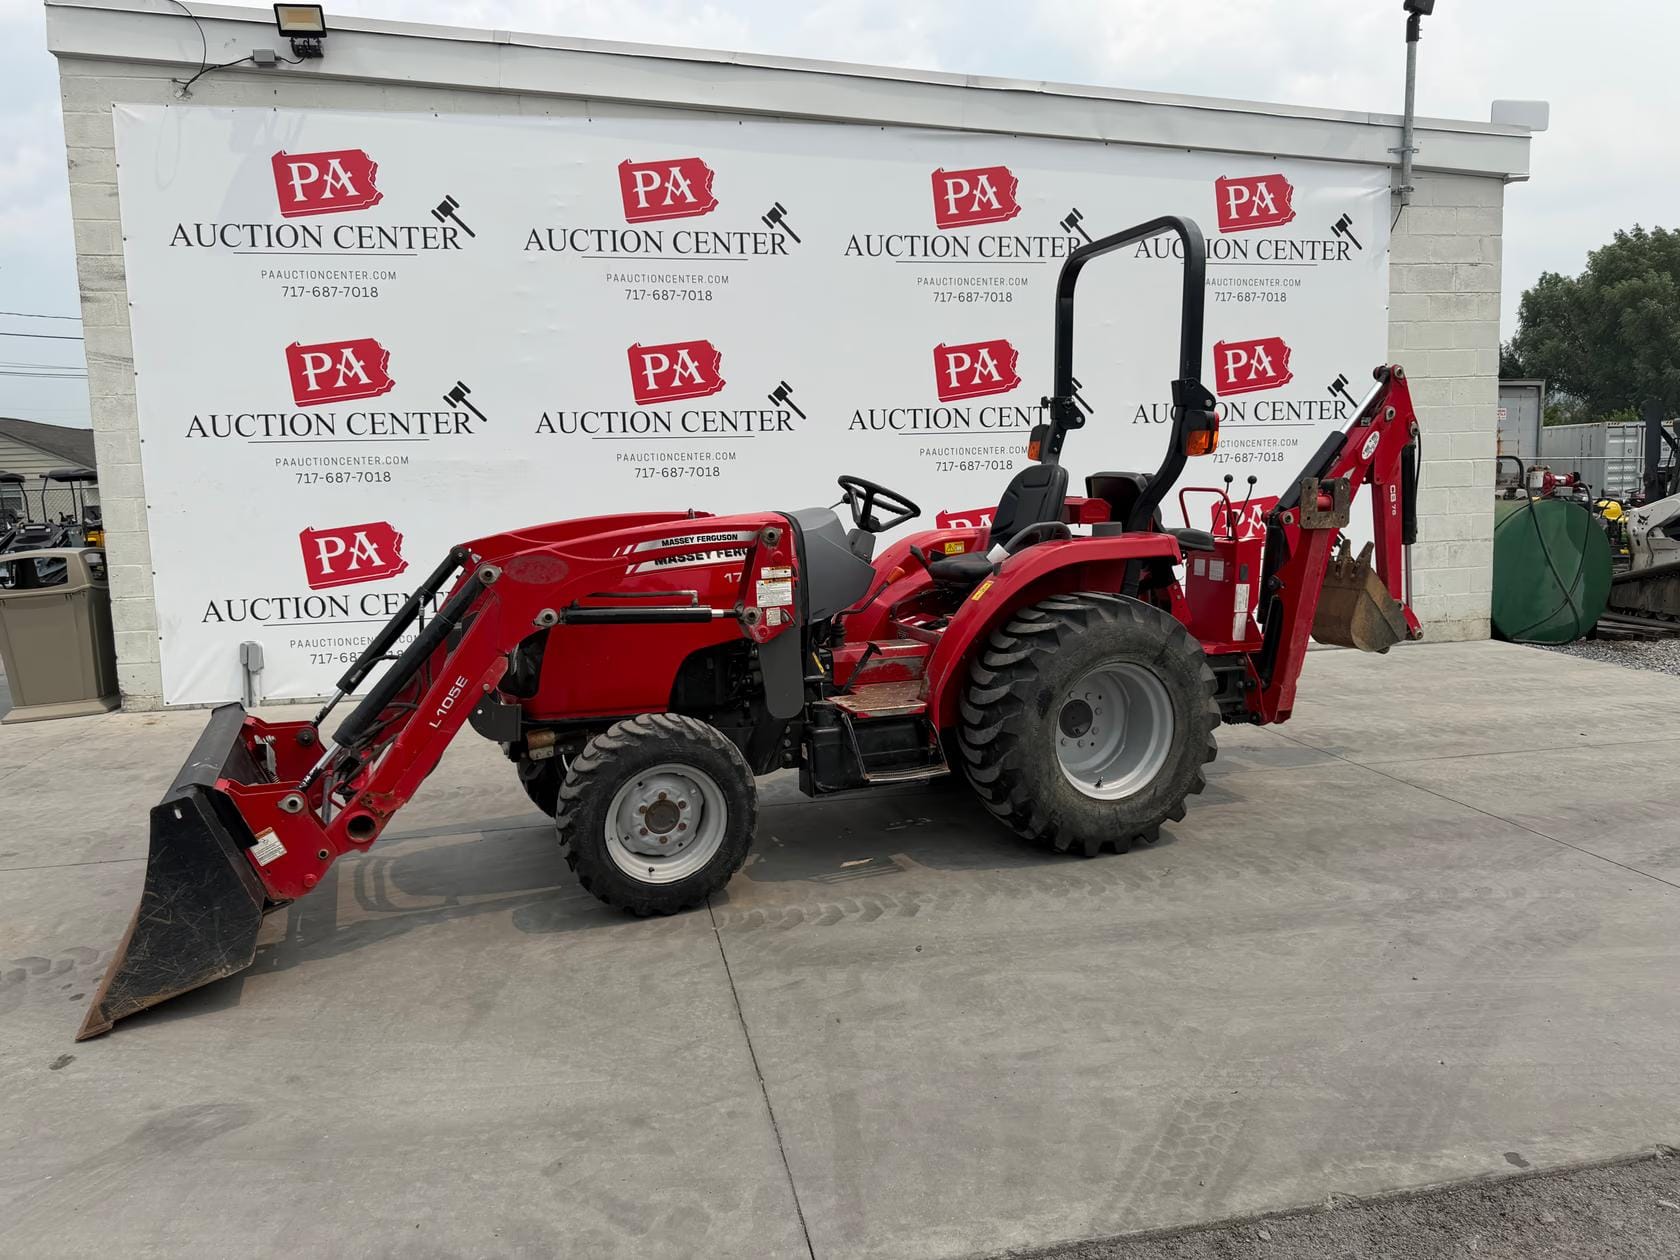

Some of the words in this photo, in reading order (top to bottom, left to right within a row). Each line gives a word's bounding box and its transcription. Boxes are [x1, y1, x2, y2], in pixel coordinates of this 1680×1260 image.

[287, 159, 359, 201] PA
[633, 167, 697, 208] PA
[944, 176, 1001, 214] PA
[1226, 182, 1278, 219] PA
[169, 223, 323, 248] AUCTION
[334, 225, 463, 249] CENTER
[524, 228, 664, 253] AUCTION
[673, 231, 789, 255] CENTER
[844, 234, 970, 257] AUCTION
[978, 235, 1081, 258] CENTER
[1134, 238, 1248, 259] AUCION
[1257, 239, 1352, 260] CENTER
[262, 270, 396, 280] PAAUCTIONCENTER.COM
[607, 274, 728, 283] PAAUCTIONCENTER.COM
[918, 278, 1027, 286] PAAUCTIONCENTER.COM
[1206, 278, 1301, 287] AAUCTIONCENTER.COM
[282, 286, 378, 297] 717-687-7018
[625, 289, 712, 301] 717-687-7018
[934, 292, 1012, 302] 717-687-7018
[1215, 292, 1286, 302] 717-687-7018
[301, 348, 372, 390] PA
[642, 350, 704, 389] PA
[946, 349, 1002, 387] PA
[1226, 346, 1275, 382] PA
[848, 408, 971, 430] AUCTION
[979, 407, 1049, 427] CENT
[1254, 401, 1348, 421] CENTER
[185, 413, 336, 438] AUCTION
[346, 412, 474, 435] CENTER
[535, 411, 672, 434] AUCTION
[681, 410, 795, 432] CENTER
[1217, 439, 1298, 448] CTIONCENTER.COM
[276, 456, 408, 466] PAAUCTIONCENTER.COM
[617, 452, 736, 461] PAAUCTIONCENTER.COM
[936, 460, 1012, 471] 717-687-7018
[1213, 452, 1283, 463] 717-687-7018
[296, 471, 391, 483] 717-687-7018
[635, 467, 720, 478] 717-687-7018
[661, 535, 695, 547] MASSEY
[697, 534, 738, 542] FERGUSON
[316, 532, 385, 573] PA
[202, 595, 350, 623] AUCTION
